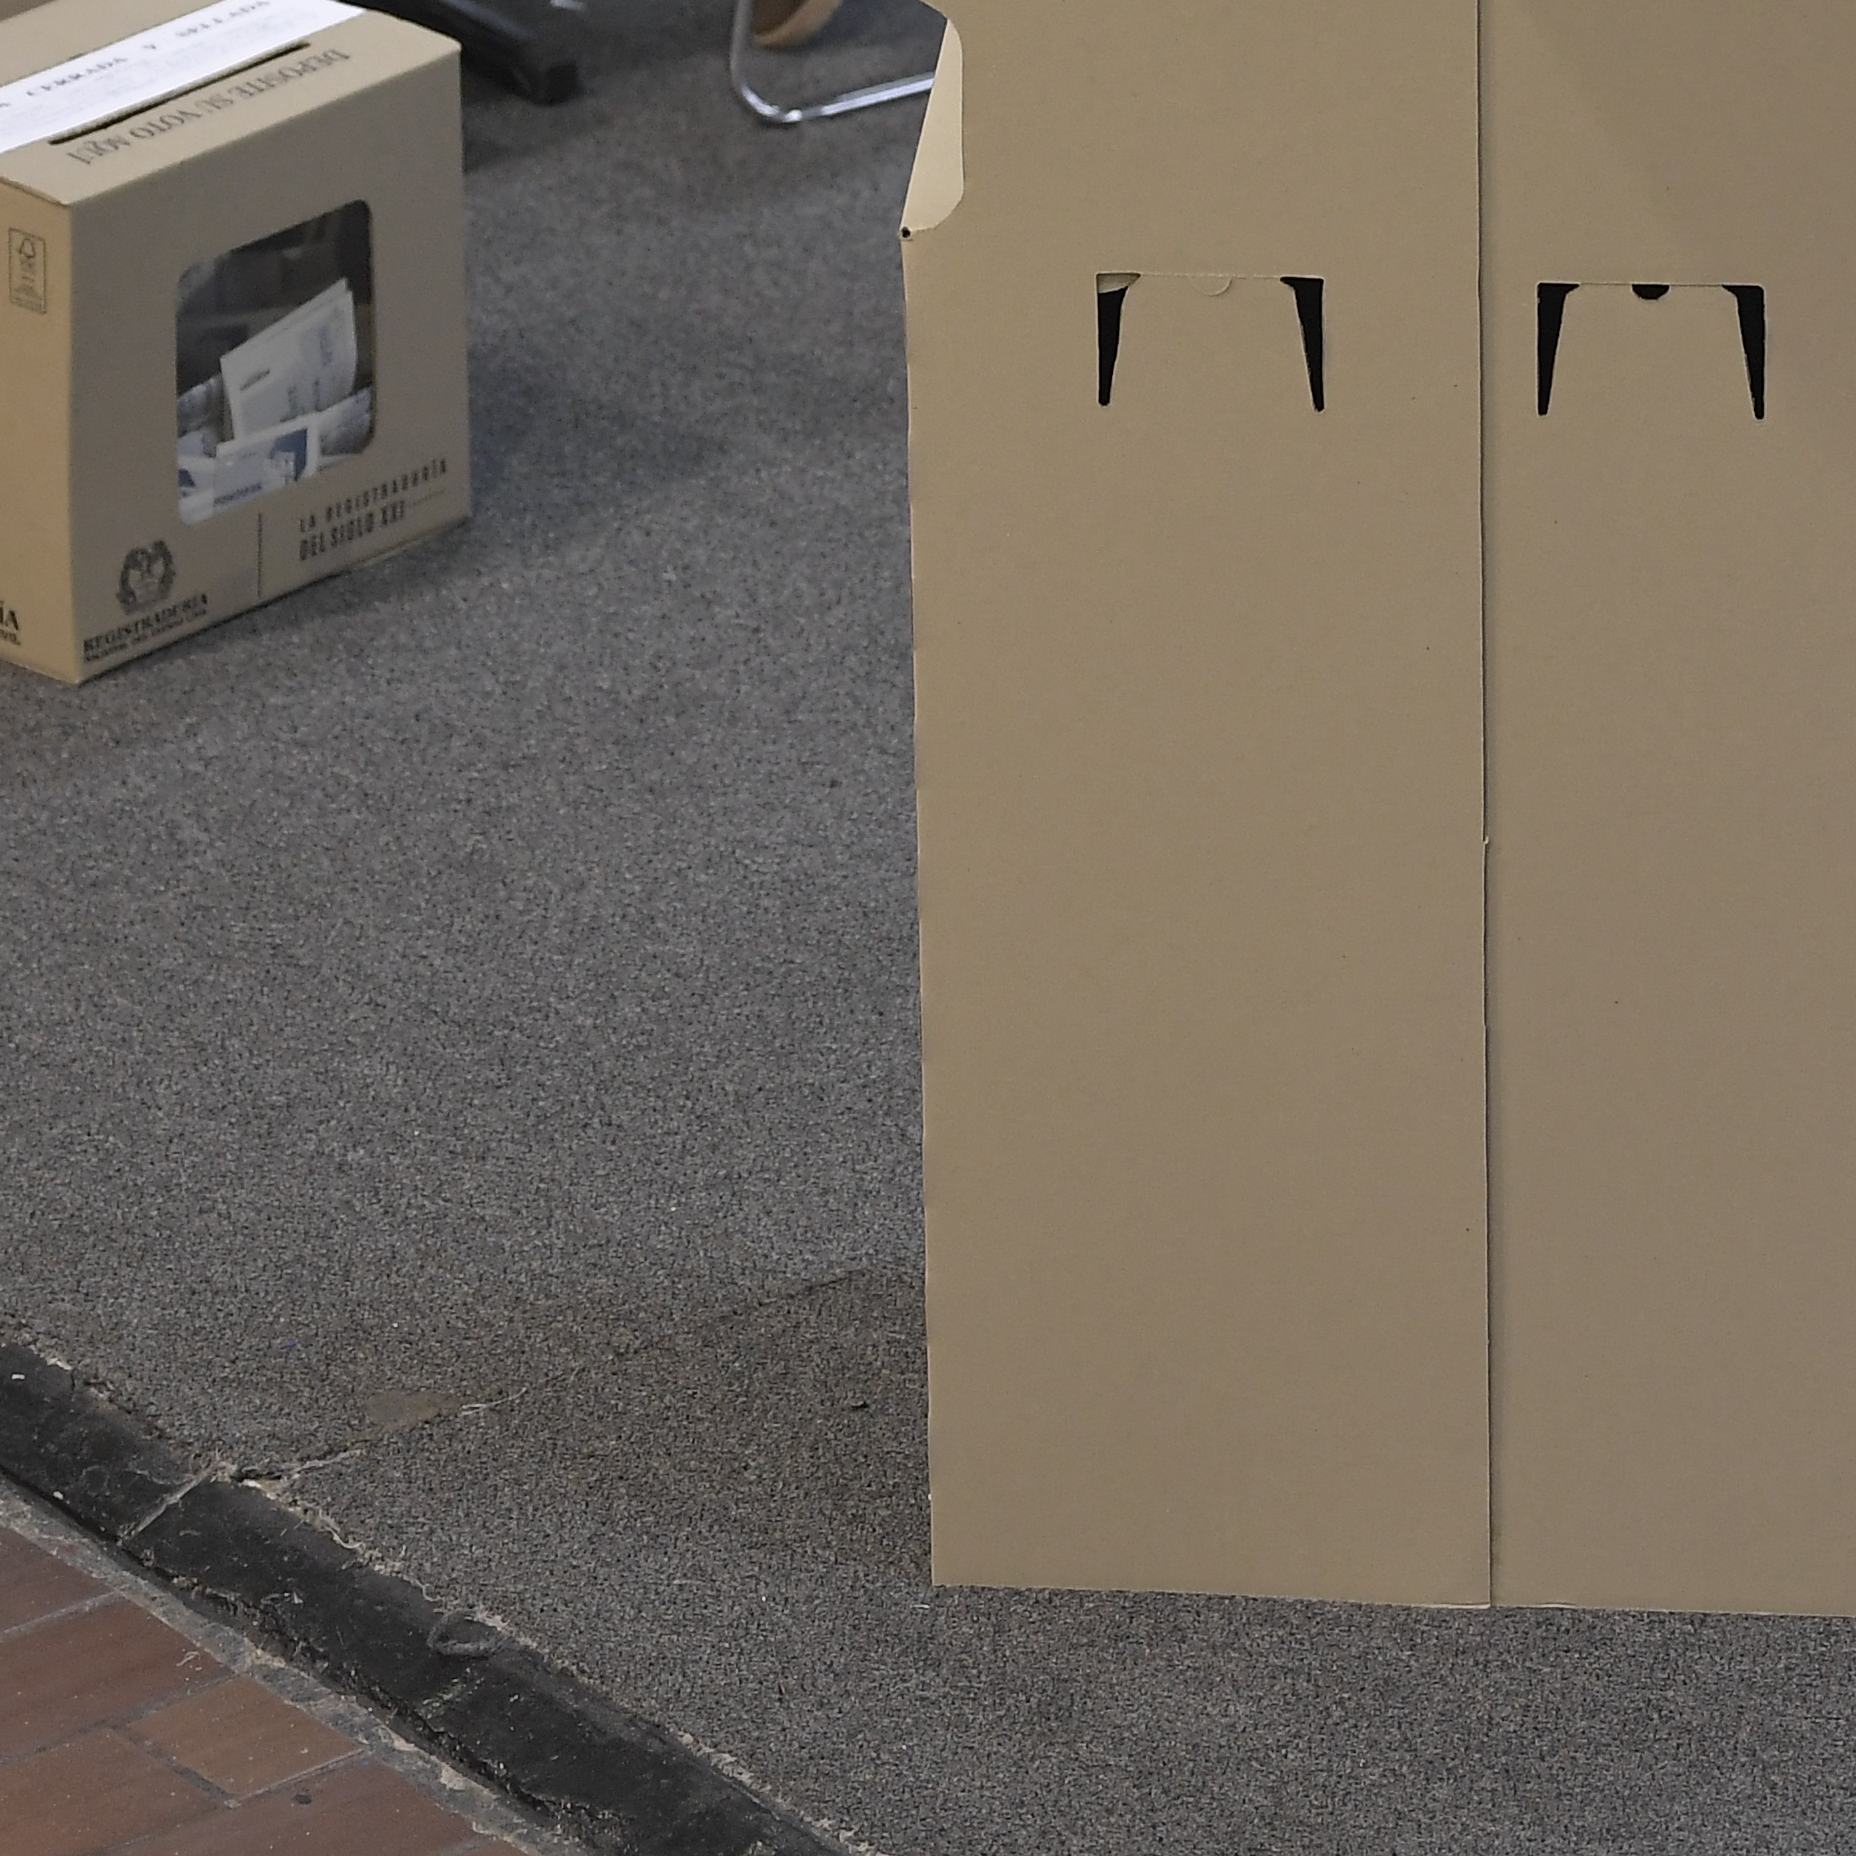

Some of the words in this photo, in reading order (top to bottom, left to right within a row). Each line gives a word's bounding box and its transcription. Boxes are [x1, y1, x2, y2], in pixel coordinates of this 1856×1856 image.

[194, 93, 235, 115] SU
[129, 108, 202, 141] VOTO
[299, 531, 326, 562] DEL
